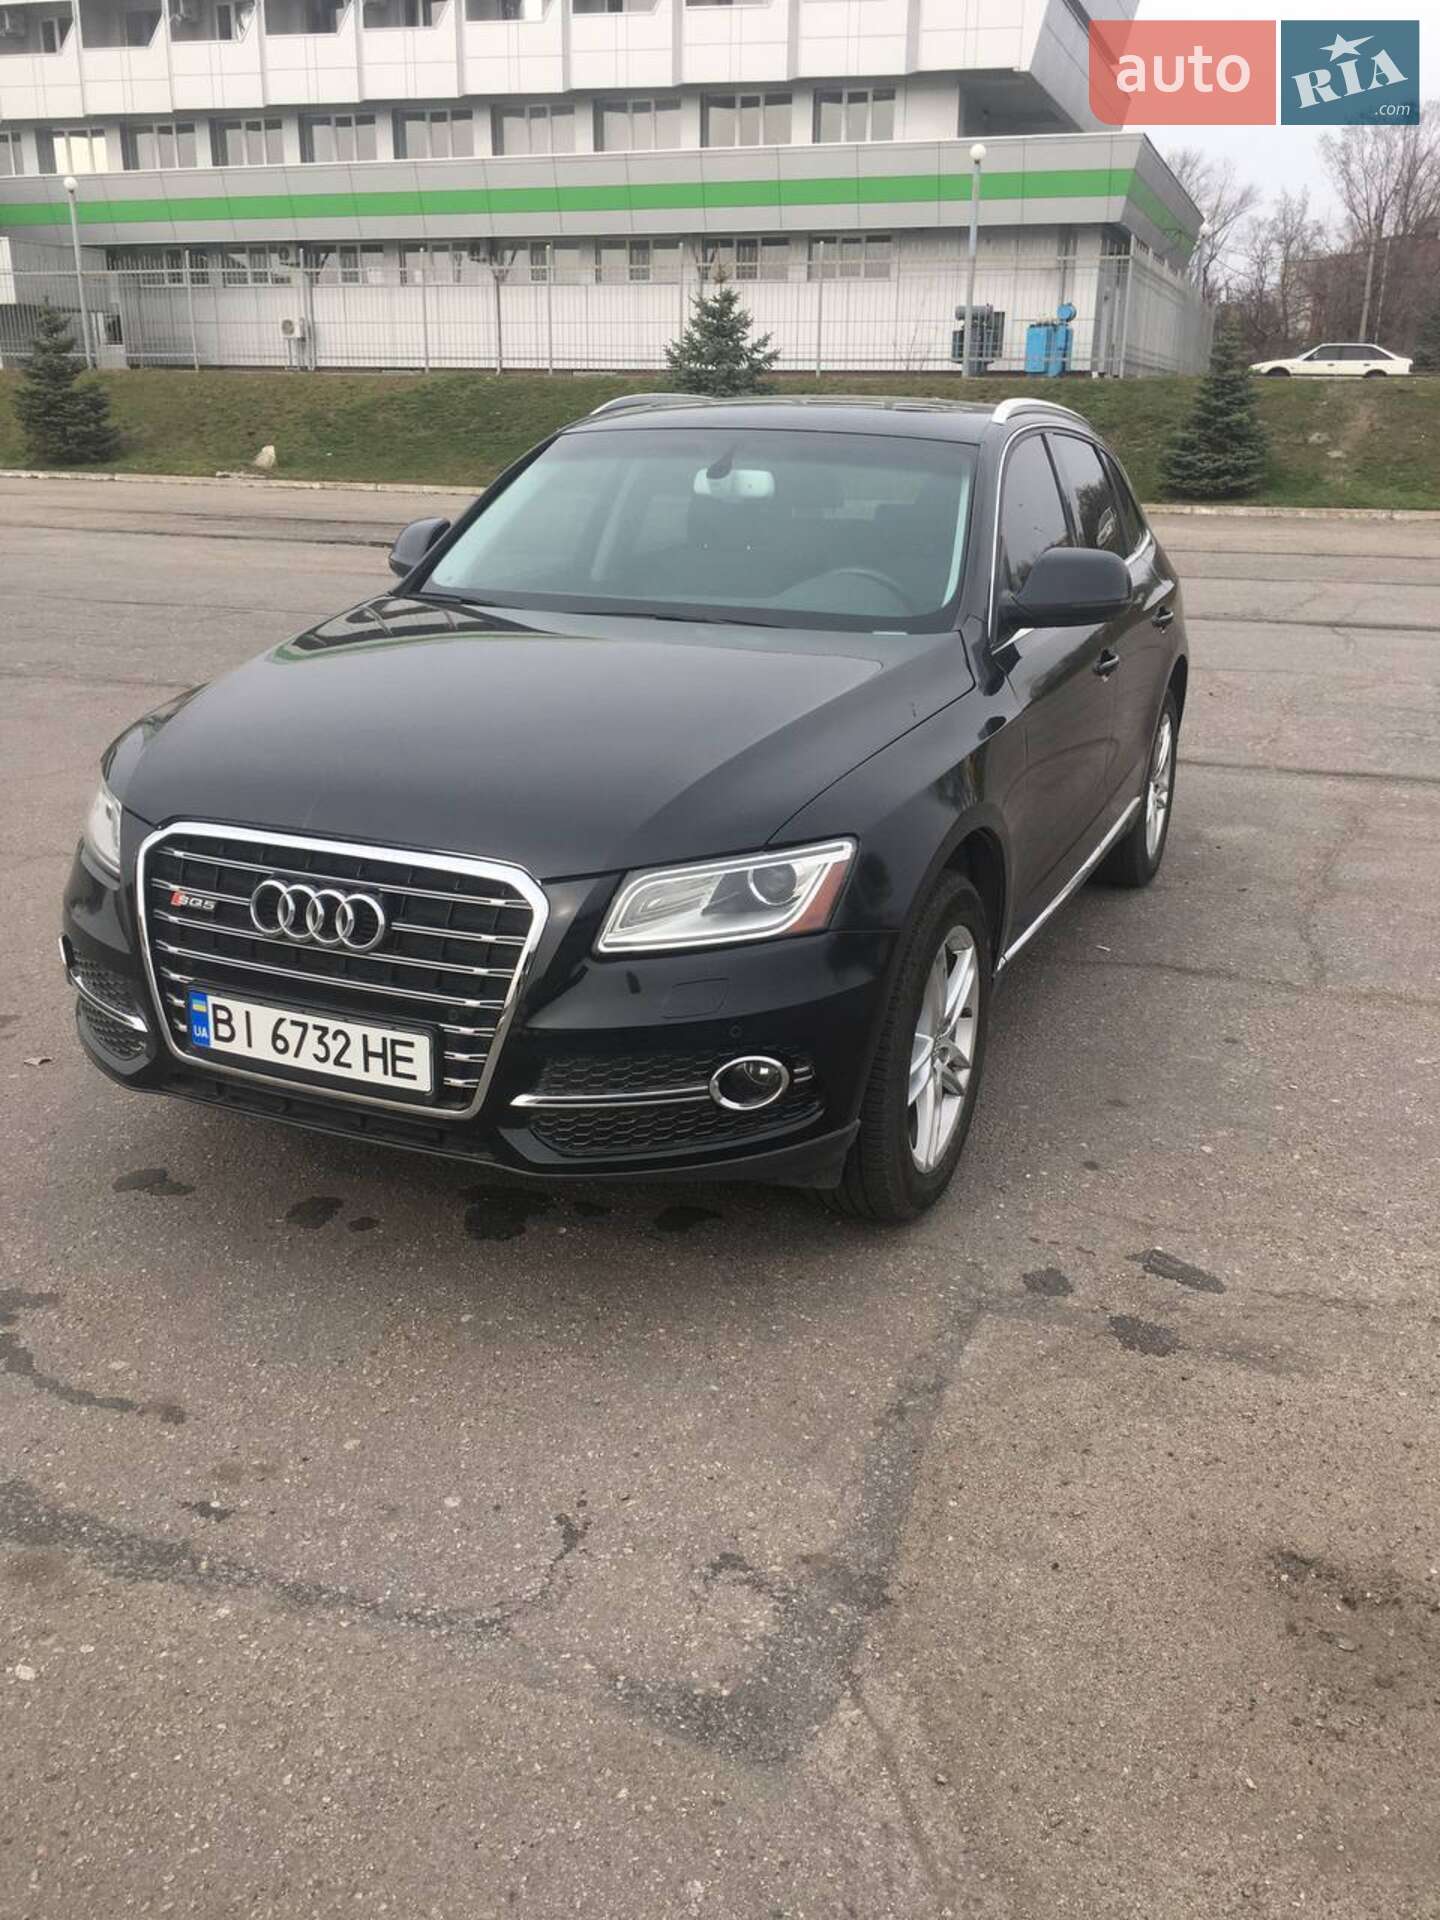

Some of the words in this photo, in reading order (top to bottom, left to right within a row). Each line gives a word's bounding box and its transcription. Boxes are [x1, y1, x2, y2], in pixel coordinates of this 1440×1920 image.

[193, 1024, 209, 1039] UA
[210, 1003, 253, 1049] BI
[270, 1017, 352, 1069] 6732
[362, 1033, 418, 1081] HE
